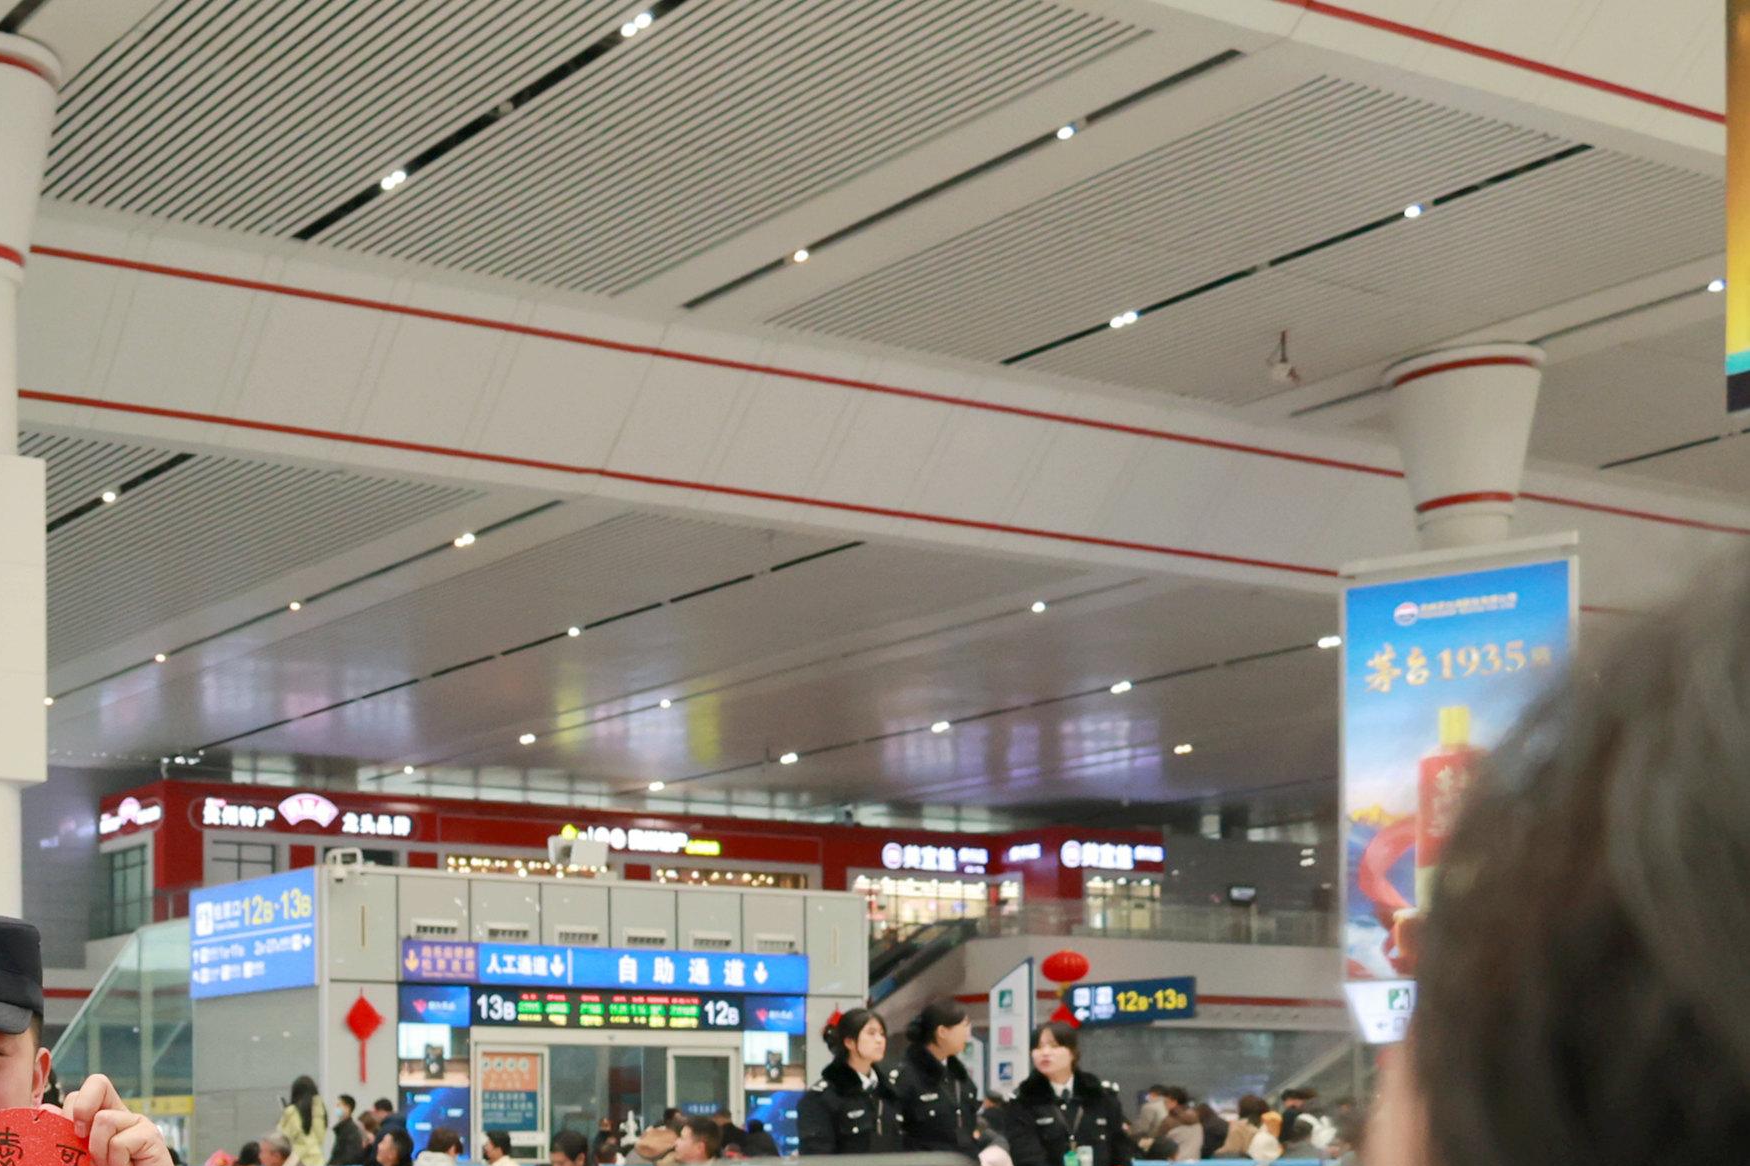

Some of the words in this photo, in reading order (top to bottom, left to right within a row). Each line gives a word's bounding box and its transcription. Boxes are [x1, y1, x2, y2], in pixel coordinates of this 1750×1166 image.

[617, 954, 746, 988] 自助通道
[476, 993, 517, 1021] 13B
[703, 1000, 740, 1026] 12B
